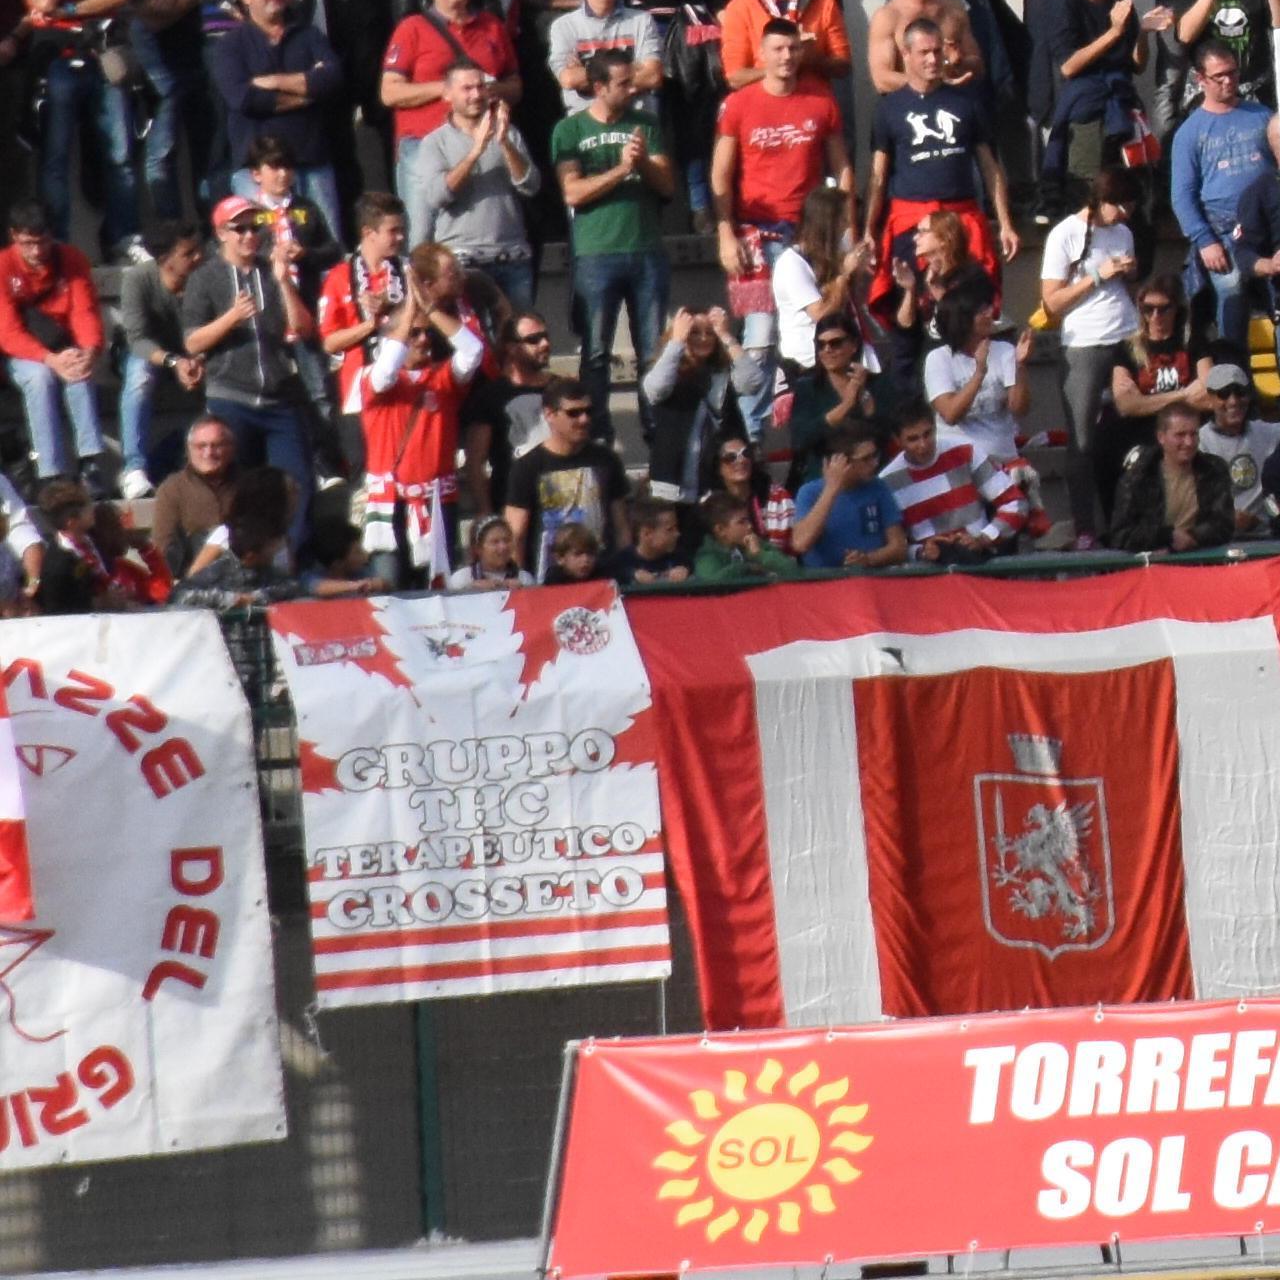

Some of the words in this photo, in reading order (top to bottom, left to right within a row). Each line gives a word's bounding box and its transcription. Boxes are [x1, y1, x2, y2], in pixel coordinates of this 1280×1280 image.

[335, 728, 617, 794] GRUPPO
[409, 782, 551, 834] THC
[314, 821, 648, 880] TERAPEUTICO
[142, 845, 225, 1003] DEL
[326, 866, 646, 930] GROSSETO
[717, 1136, 811, 1170] SOL
[1037, 1135, 1193, 1220] SOL
